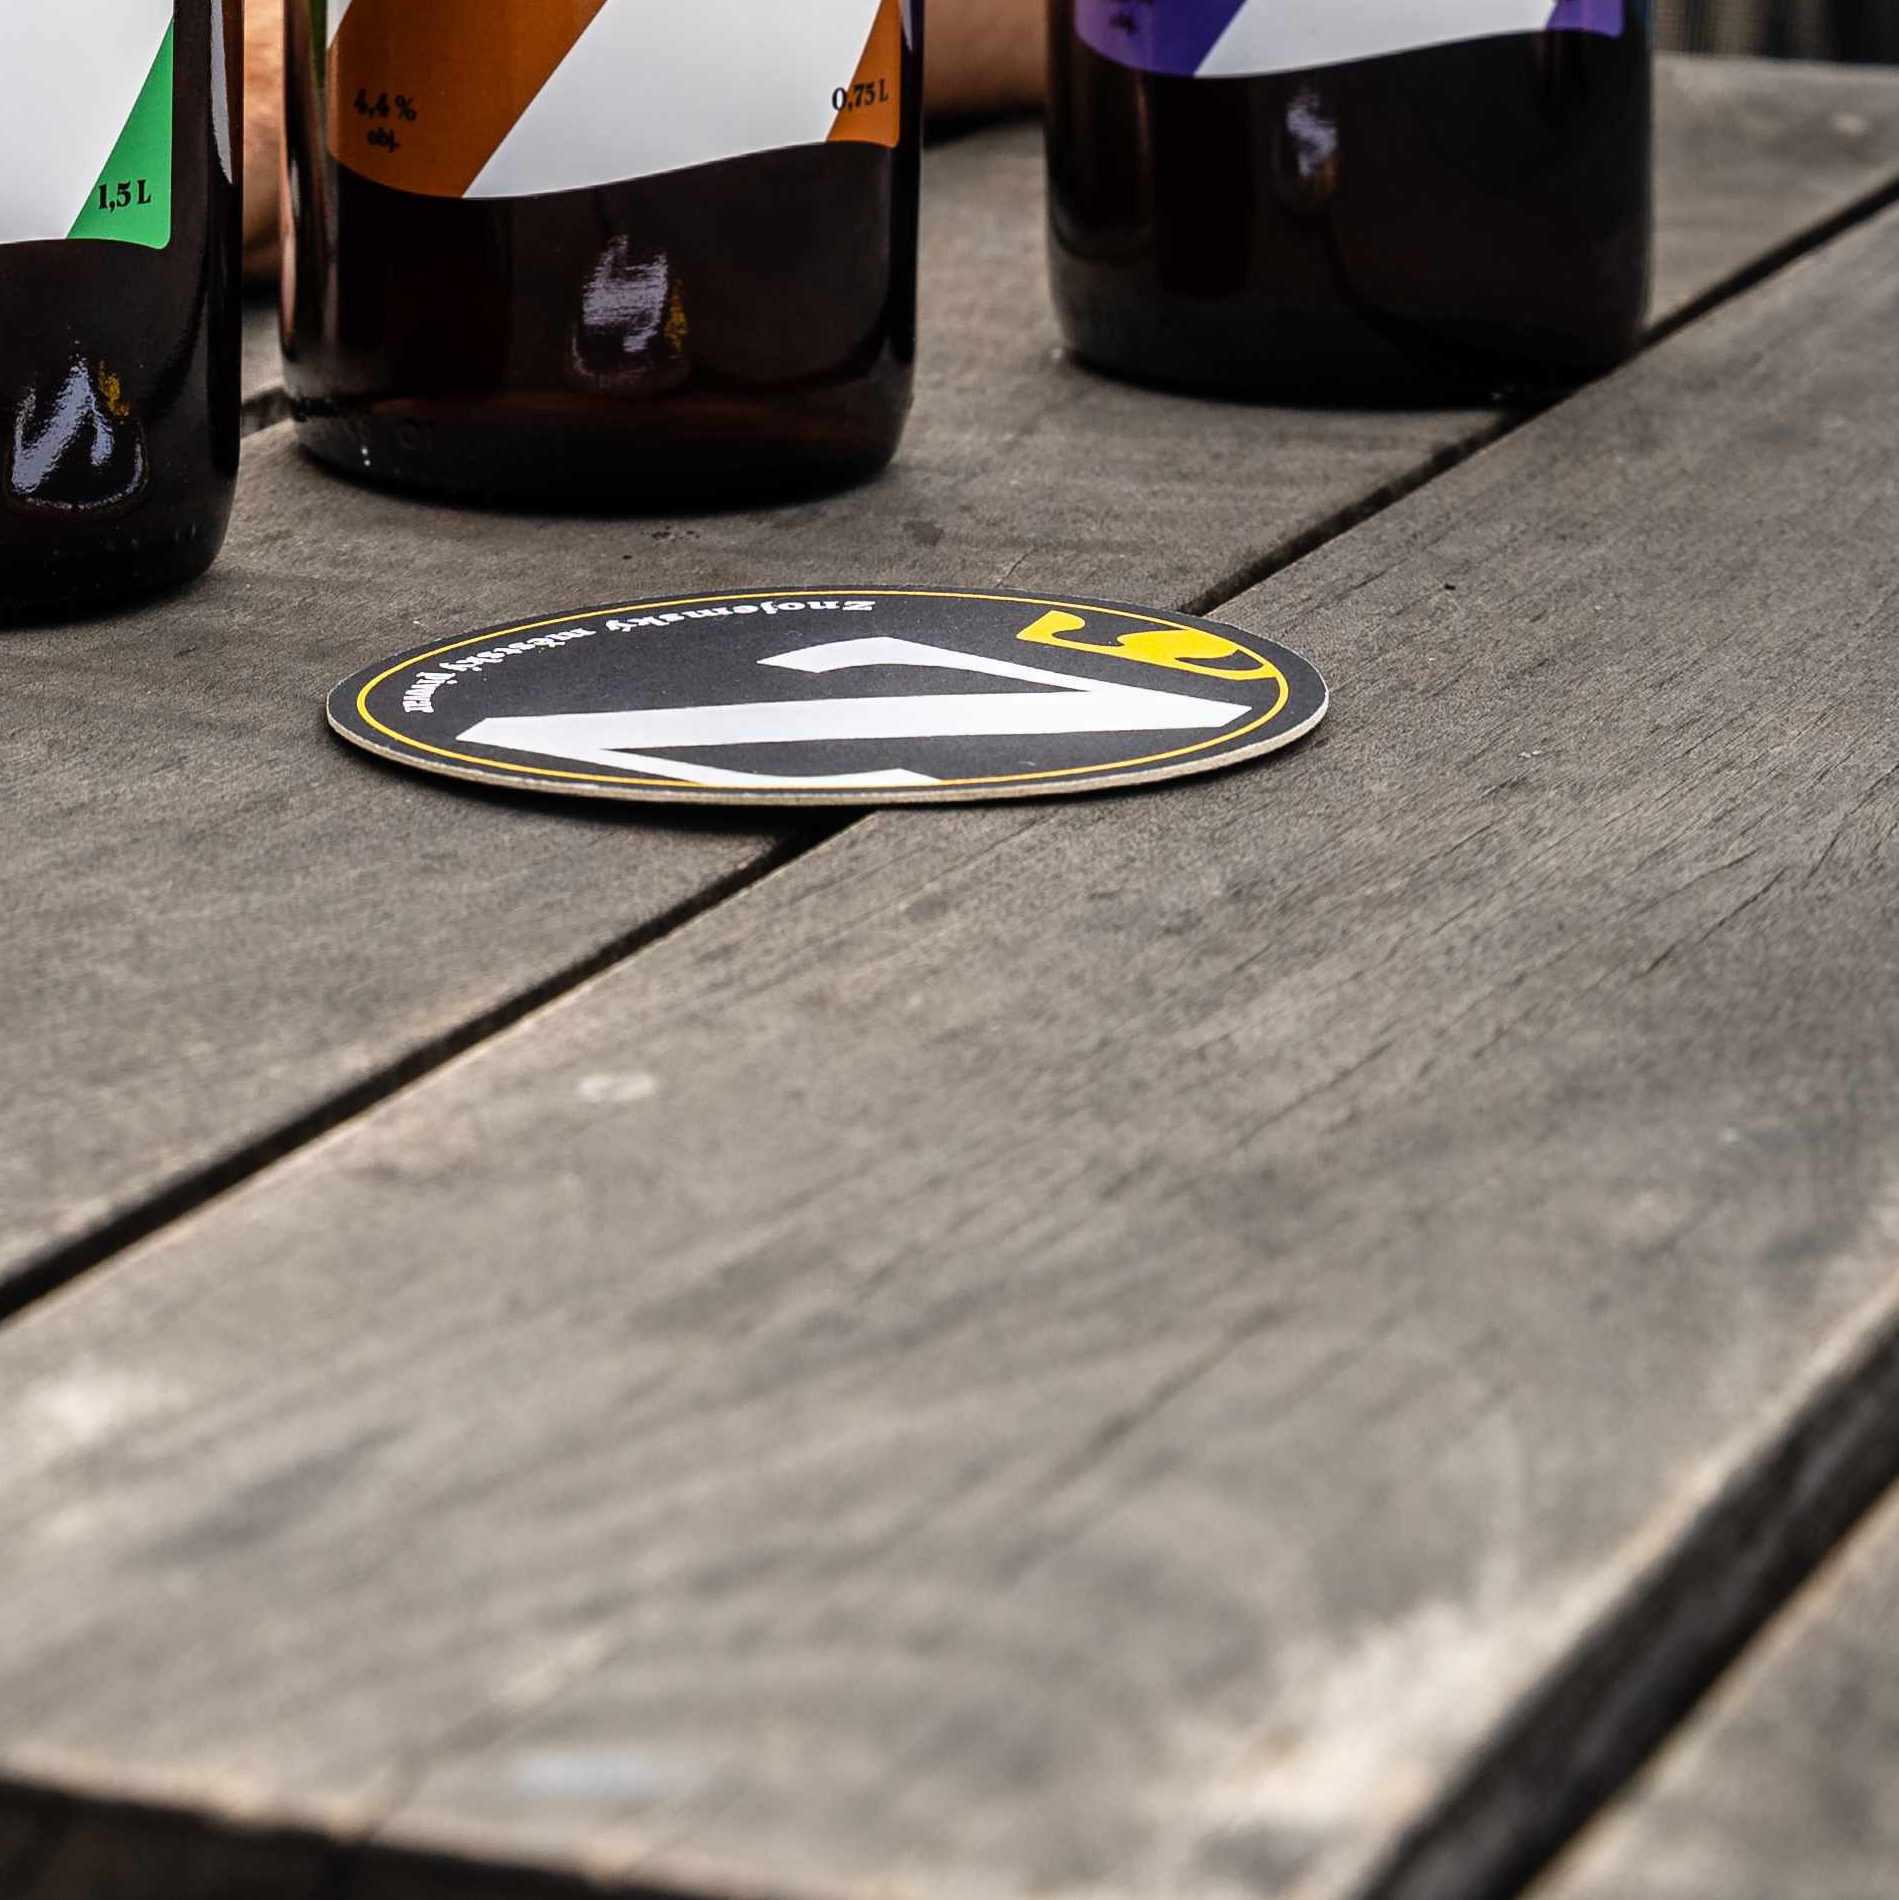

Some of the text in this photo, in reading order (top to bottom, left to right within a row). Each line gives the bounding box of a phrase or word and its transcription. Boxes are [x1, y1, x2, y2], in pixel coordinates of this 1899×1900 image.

[395, 94, 417, 122] %
[831, 77, 890, 113] 0,75 L
[98, 178, 152, 214] 1,5 L
[604, 599, 877, 633] Znojemský
[438, 627, 597, 672] městský
